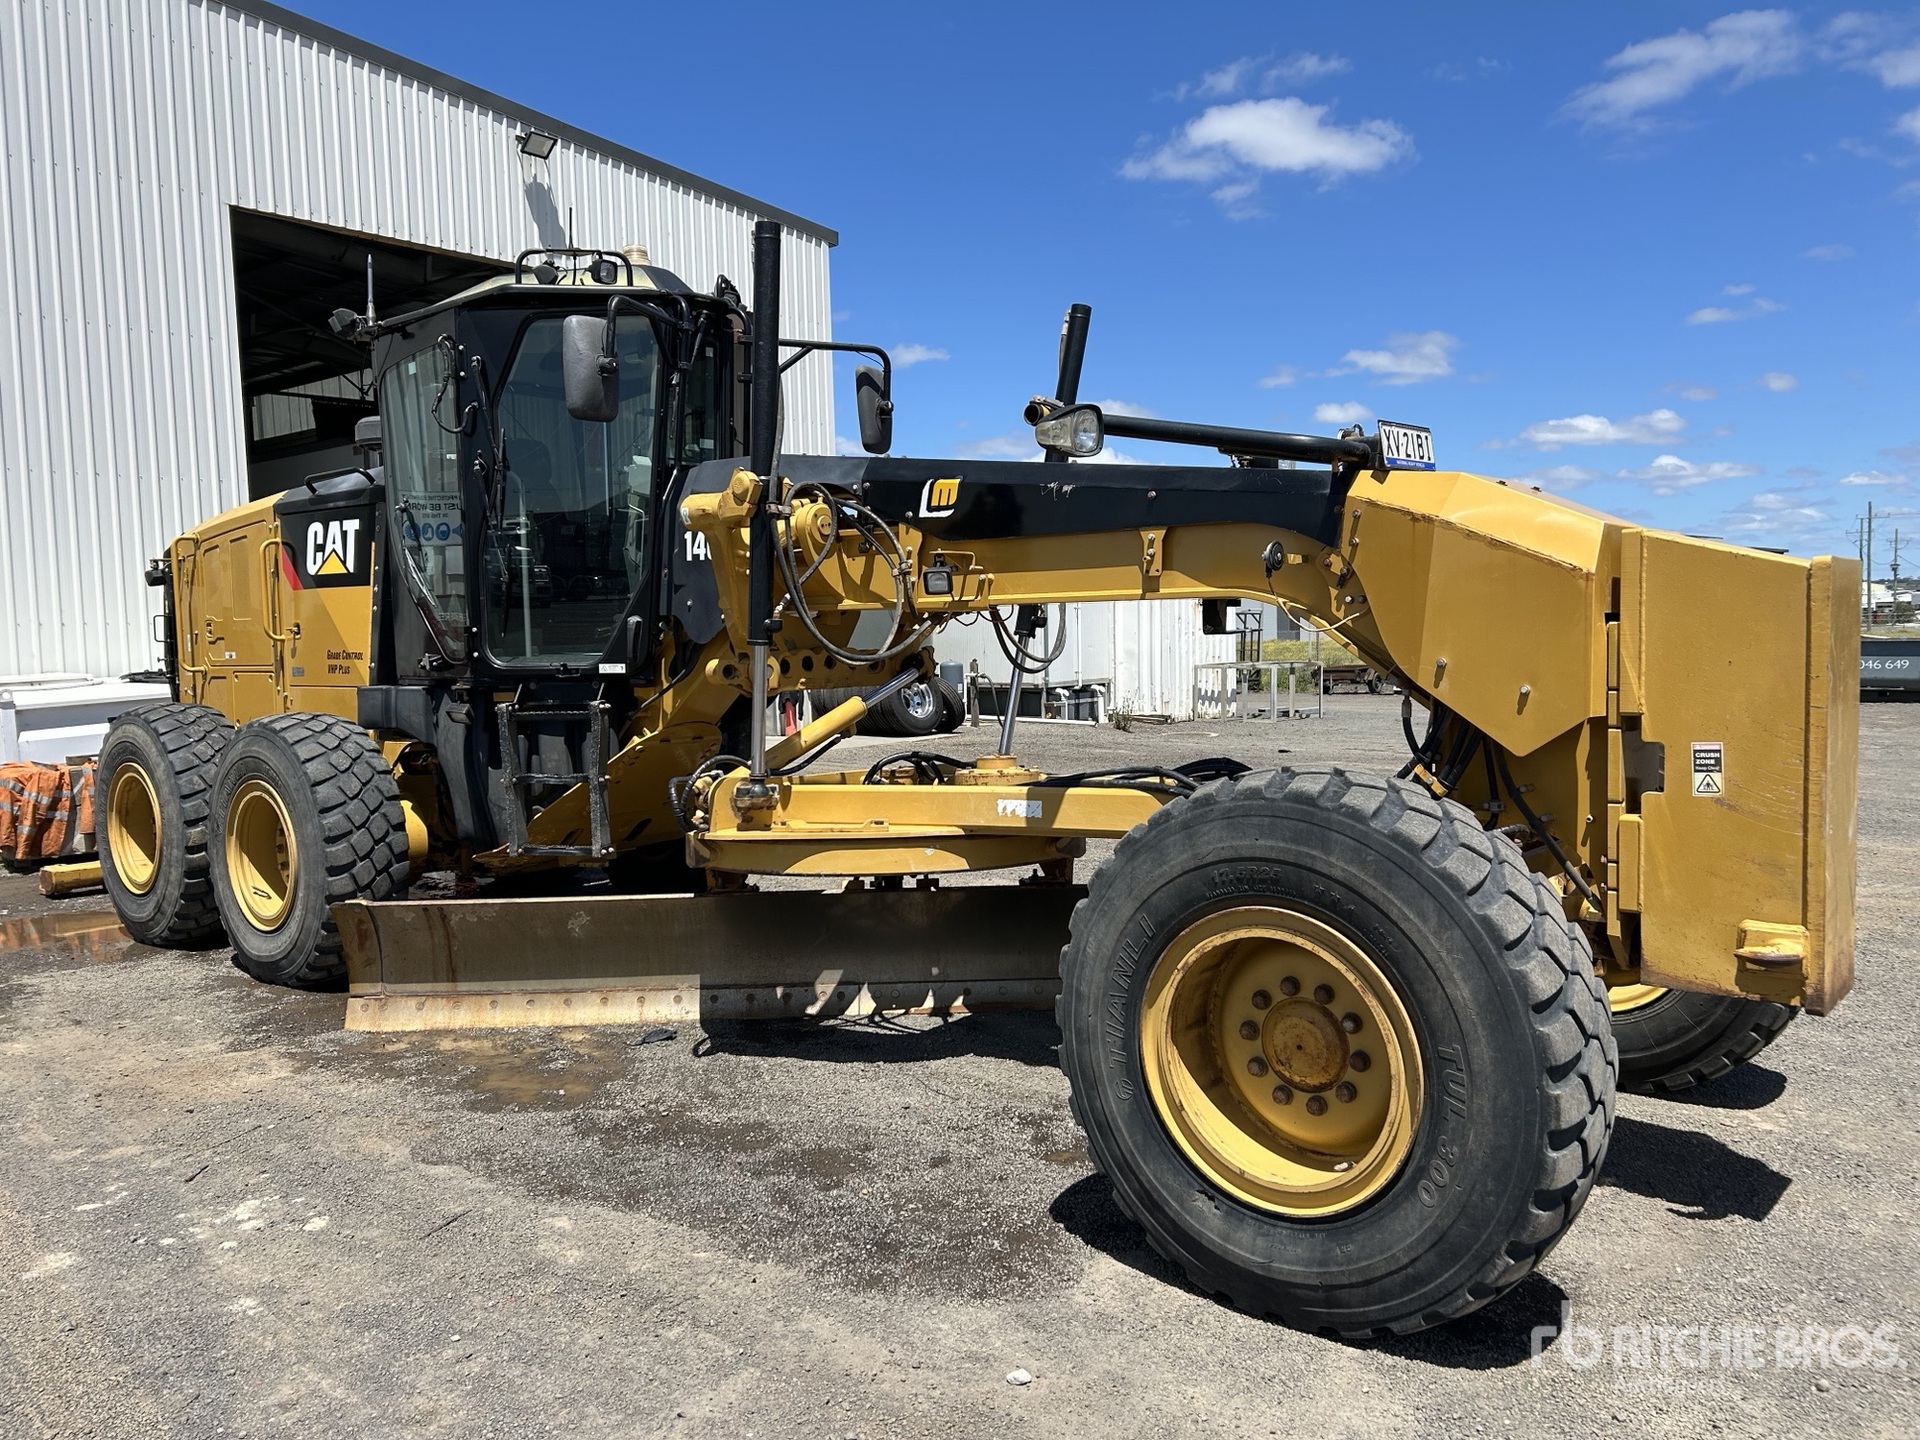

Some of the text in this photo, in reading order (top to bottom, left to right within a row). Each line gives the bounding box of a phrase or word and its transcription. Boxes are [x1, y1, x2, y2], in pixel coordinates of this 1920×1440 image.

[306, 518, 360, 576] CAT
[684, 531, 712, 562] 14
[1885, 659, 1910, 669] 649
[1107, 913, 1157, 1070] TIANLI
